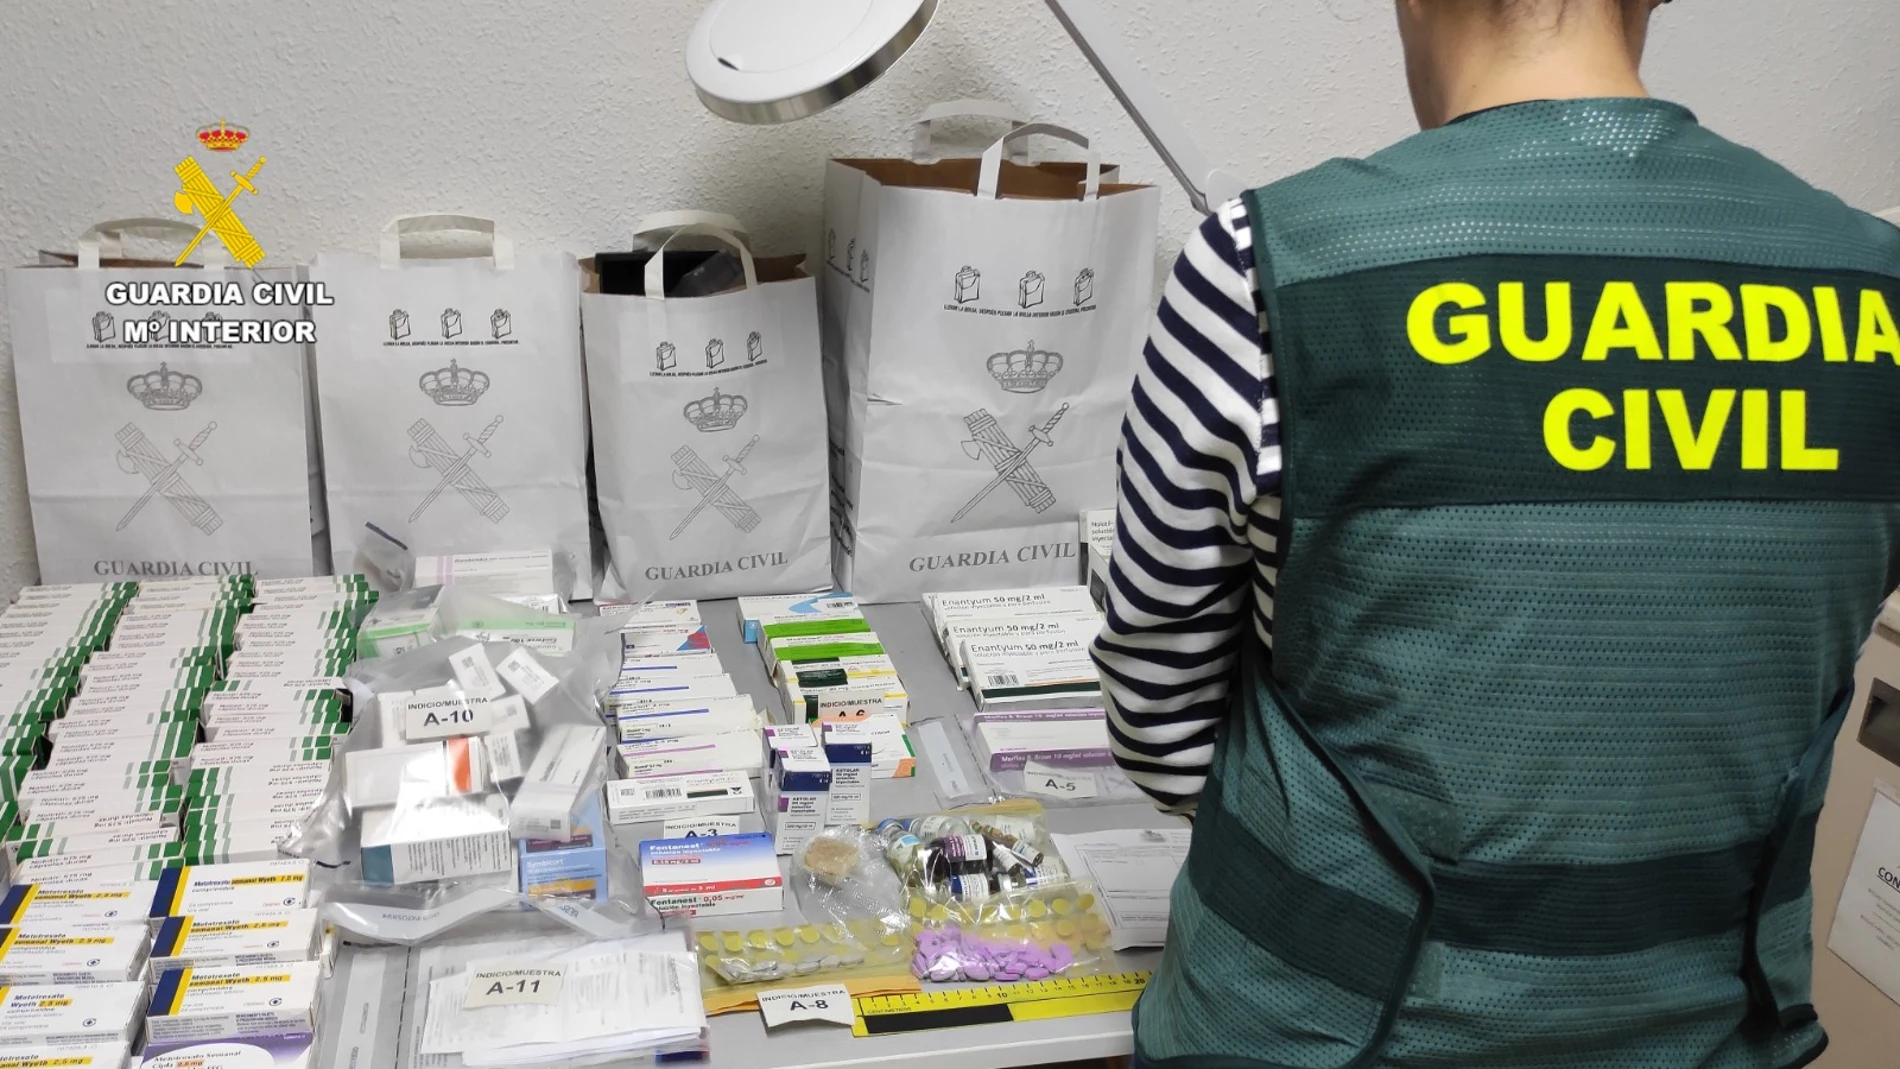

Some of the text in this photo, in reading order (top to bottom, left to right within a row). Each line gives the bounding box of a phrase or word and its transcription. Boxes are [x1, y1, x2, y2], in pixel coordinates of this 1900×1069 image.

[1406, 281, 1900, 365] GUARDIA
[1542, 387, 1840, 471] CIVIL
[908, 542, 1077, 573] GUARDIA CIVIL
[94, 561, 258, 577] GUARDIA CIVIL
[645, 551, 788, 582] GUARDIA CIVIL
[942, 597, 991, 607] Enantyum
[1006, 595, 1032, 604] mg/2
[1033, 593, 1046, 601] ml
[953, 625, 1004, 635] Enantyum
[1007, 624, 1019, 632] 50
[1020, 623, 1045, 633] mg/2
[971, 644, 1024, 654] Enantyum
[1025, 643, 1037, 651] 50
[1038, 642, 1064, 652] mg/2
[423, 708, 475, 727] A-10
[839, 709, 867, 717] A6
[1044, 778, 1077, 793] A-5
[685, 828, 719, 838] A-3
[527, 858, 564, 869] Symbicort
[650, 896, 698, 906] Fentanest
[474, 968, 562, 981] INDICIO/MUESTRA
[485, 978, 542, 996] A-11
[761, 989, 846, 1003] INDICIO/MUESTRA
[789, 999, 829, 1012] A-8
